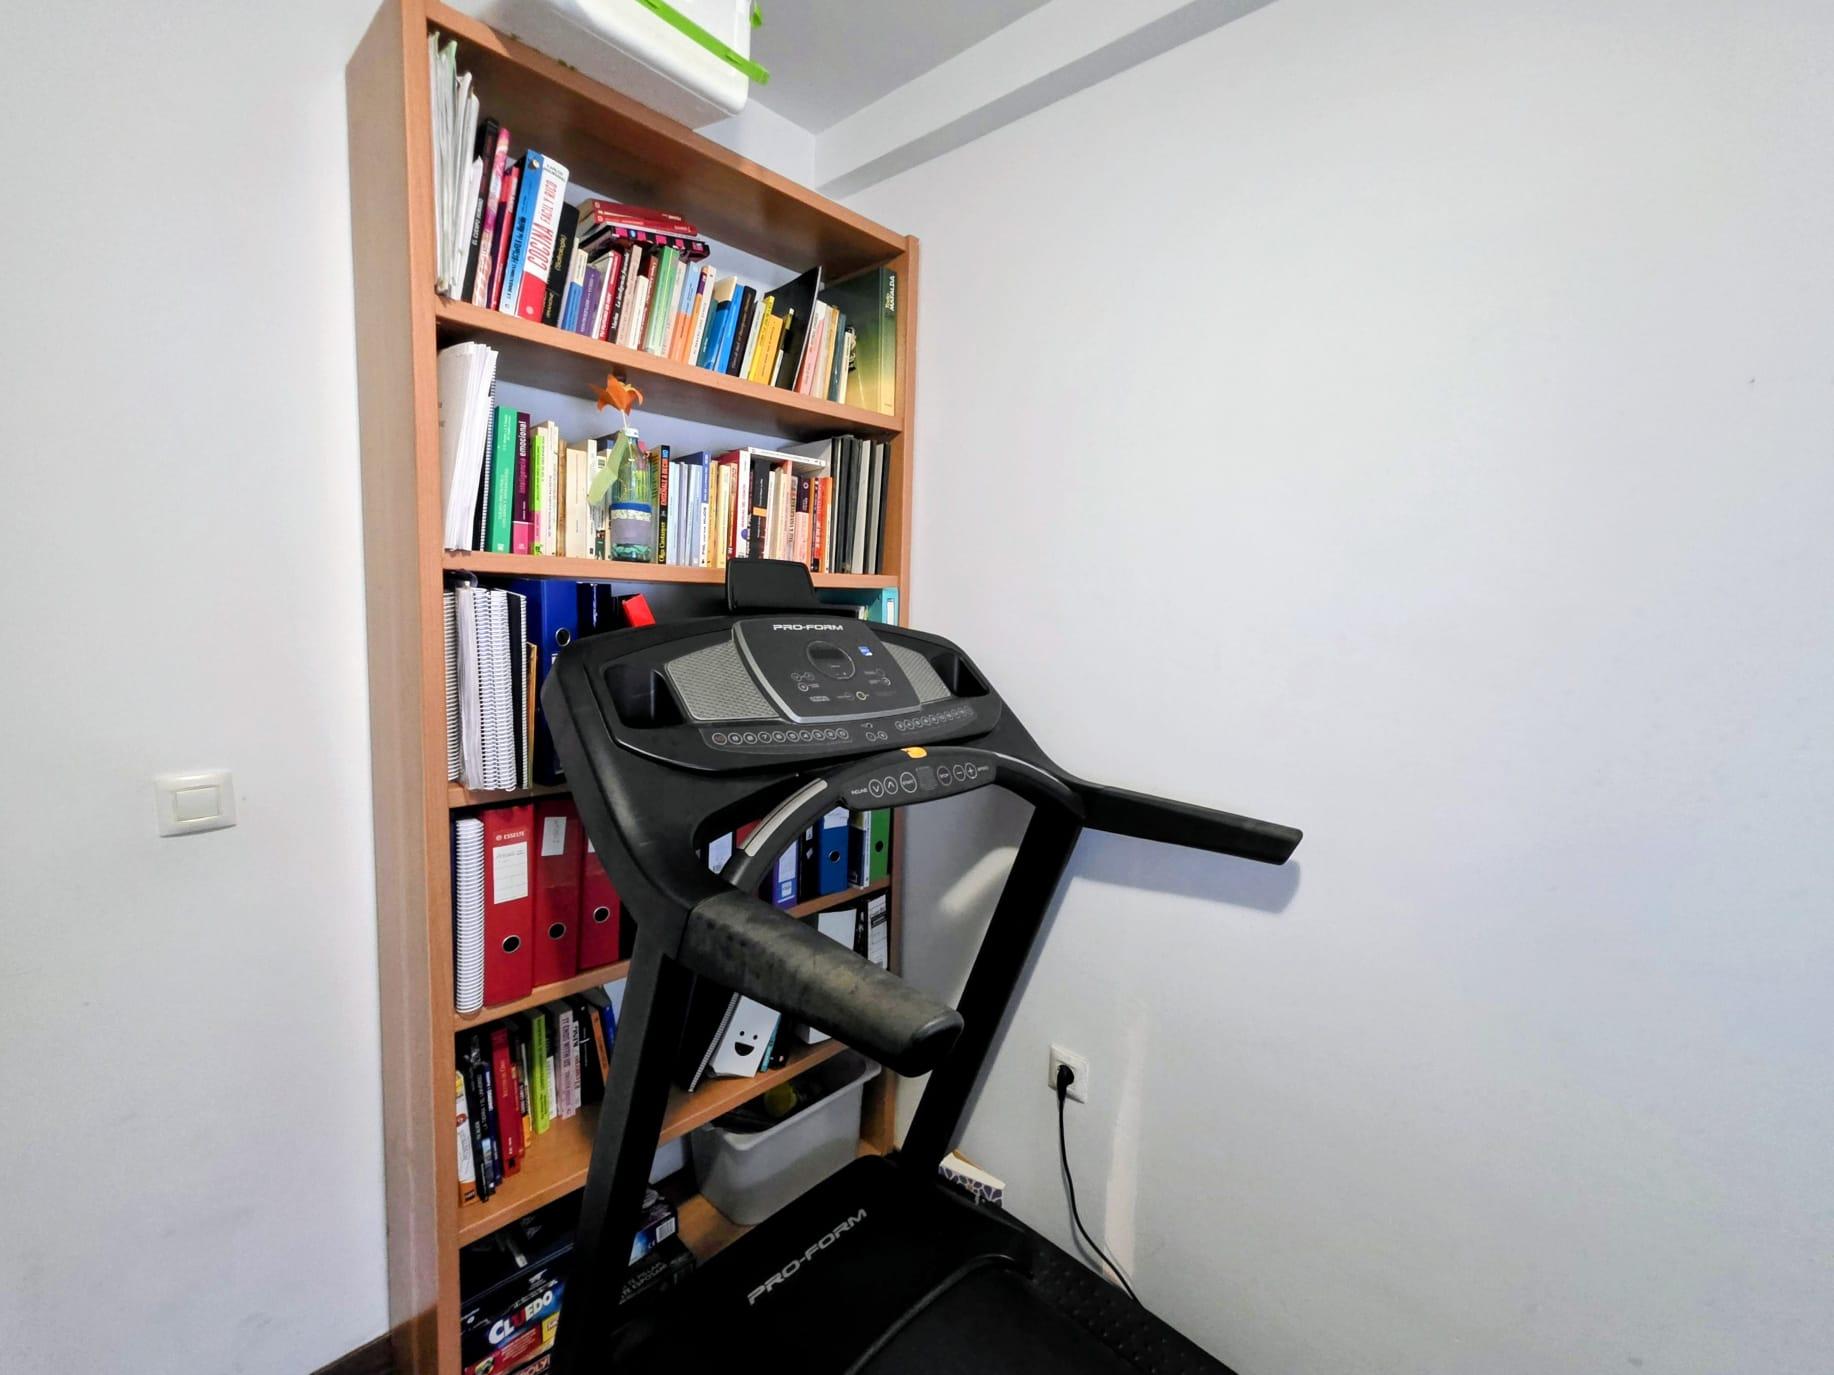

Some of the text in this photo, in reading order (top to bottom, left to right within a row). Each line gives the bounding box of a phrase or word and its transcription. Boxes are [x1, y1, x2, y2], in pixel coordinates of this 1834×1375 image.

[472, 218, 480, 238] CUERPO
[527, 222, 553, 271] COCINA
[544, 179, 556, 198] RICO
[518, 420, 526, 456] emocional
[518, 458, 526, 493] inteligencia
[503, 831, 525, 840] ESSELTE
[561, 1025, 569, 1041] ENDS
[561, 1041, 570, 1058] WITH
[747, 1208, 867, 1306] PRO-FORM
[488, 1290, 553, 1344] CLUEDO
